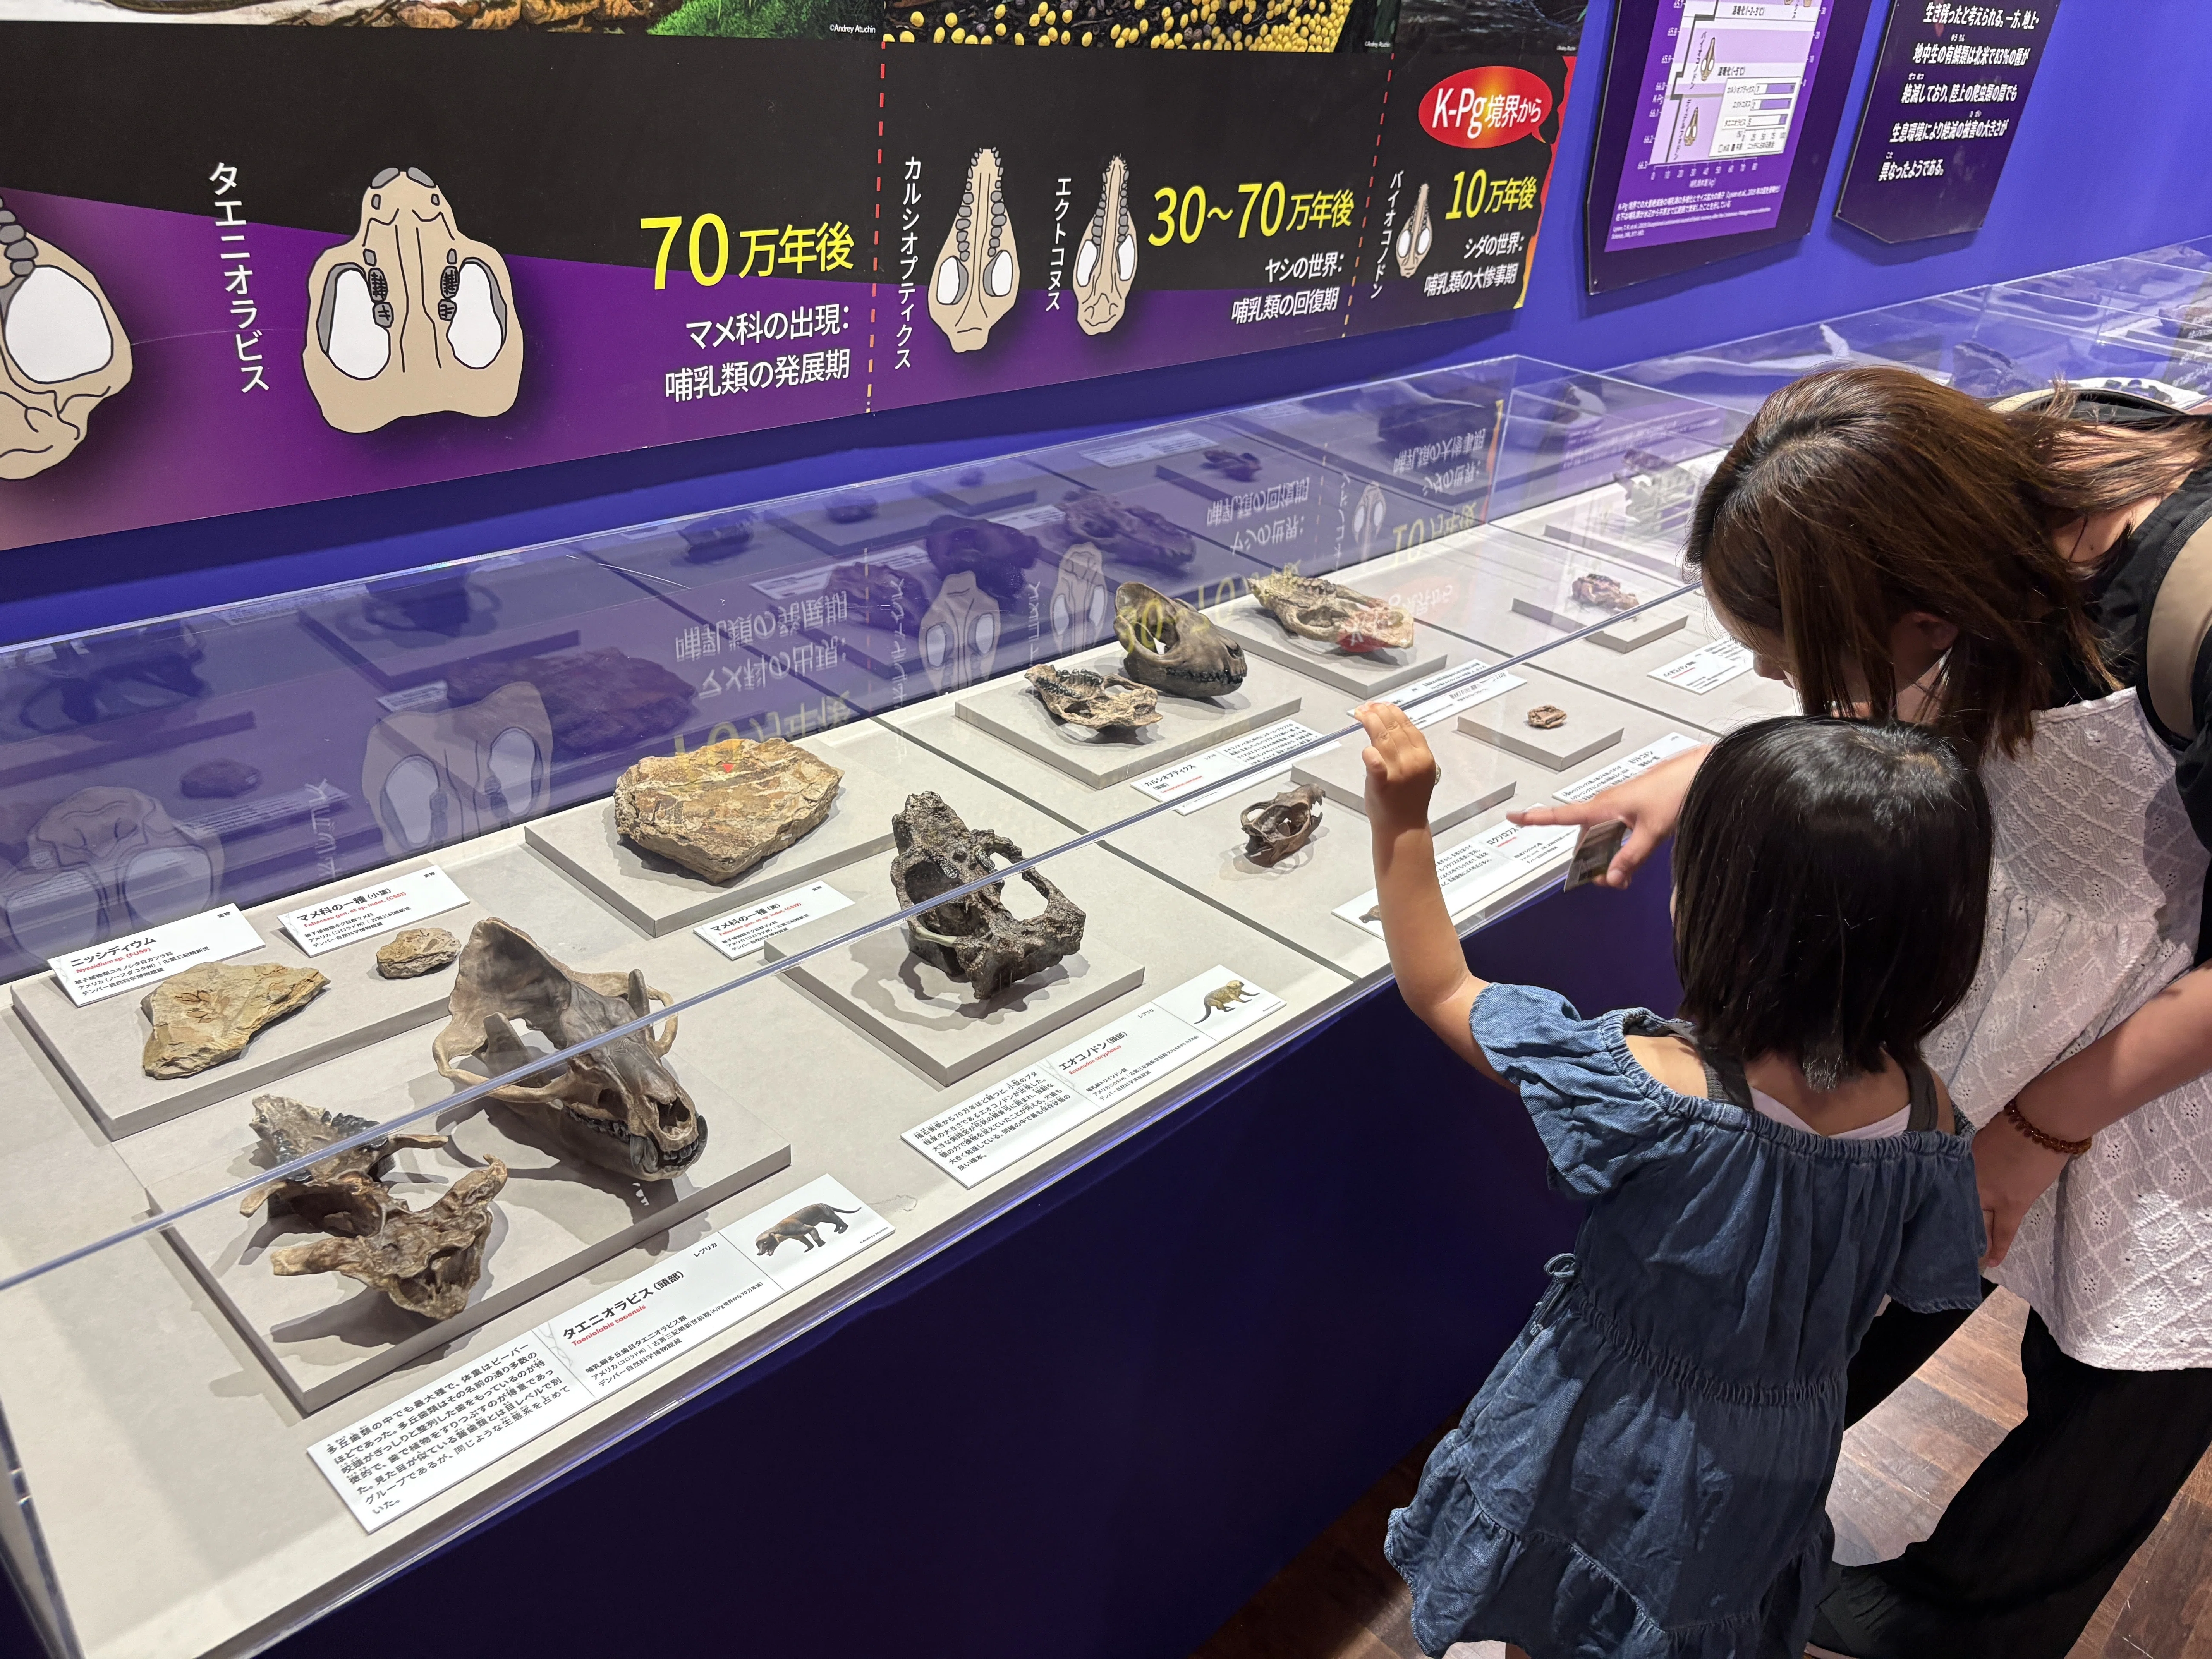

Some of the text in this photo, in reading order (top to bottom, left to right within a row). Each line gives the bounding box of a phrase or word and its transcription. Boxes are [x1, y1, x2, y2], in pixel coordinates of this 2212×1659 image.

[855, 25, 876, 33] Atuchin
[1432, 88, 1542, 139] K-Pg境界から
[1445, 169, 1537, 220] 10万年後
[640, 213, 854, 290] 70万年後
[1046, 179, 1072, 311] エクトコヌス
[1370, 170, 1404, 299] バイオコノドン
[209, 162, 269, 393] タエニオラビス
[895, 156, 921, 369] カルシオプティクス
[1265, 252, 1344, 282] ヤシの世界：
[1424, 263, 1518, 297] 哺乳類の大惨事期
[685, 304, 849, 349] マメ科の出現：
[1231, 287, 1339, 324] 哺乳類の回復期
[665, 349, 850, 402] 哺乳類の発展期
[1143, 763, 1197, 787] カルシオプティクス
[69, 935, 157, 968] ニッシディウム
[75, 958, 114, 974] Nyssidium
[1137, 1008, 1155, 1018] レプリカ
[1057, 1030, 1129, 1071] エオコノドン（頭部）
[692, 1242, 718, 1257] レプリカ
[559, 1269, 687, 1340] タエニオラビス（頭部）
[571, 1304, 647, 1346] Taeniolabis taoensis
[584, 1315, 688, 1374] 哺乳綱多丘歯目タエニオラビス類
[597, 1338, 683, 1387] デンバー自然科学博物館蔵
[326, 1342, 530, 1455] 多丘歯類の中でも最大種で、体重はビーバー
[333, 1351, 538, 1465] ほどであった。多丘歯類はその名前の通り多数の
[341, 1359, 546, 1475] 咬頭がぎっしりと整列した歯をもっているのが特
[348, 1368, 554, 1485] 徴的で、歯で植物をすりつぶすのが得意であっ
[364, 1385, 571, 1505] グループであるが、同じような生態系を占めて
[372, 1496, 400, 1516] いた。
